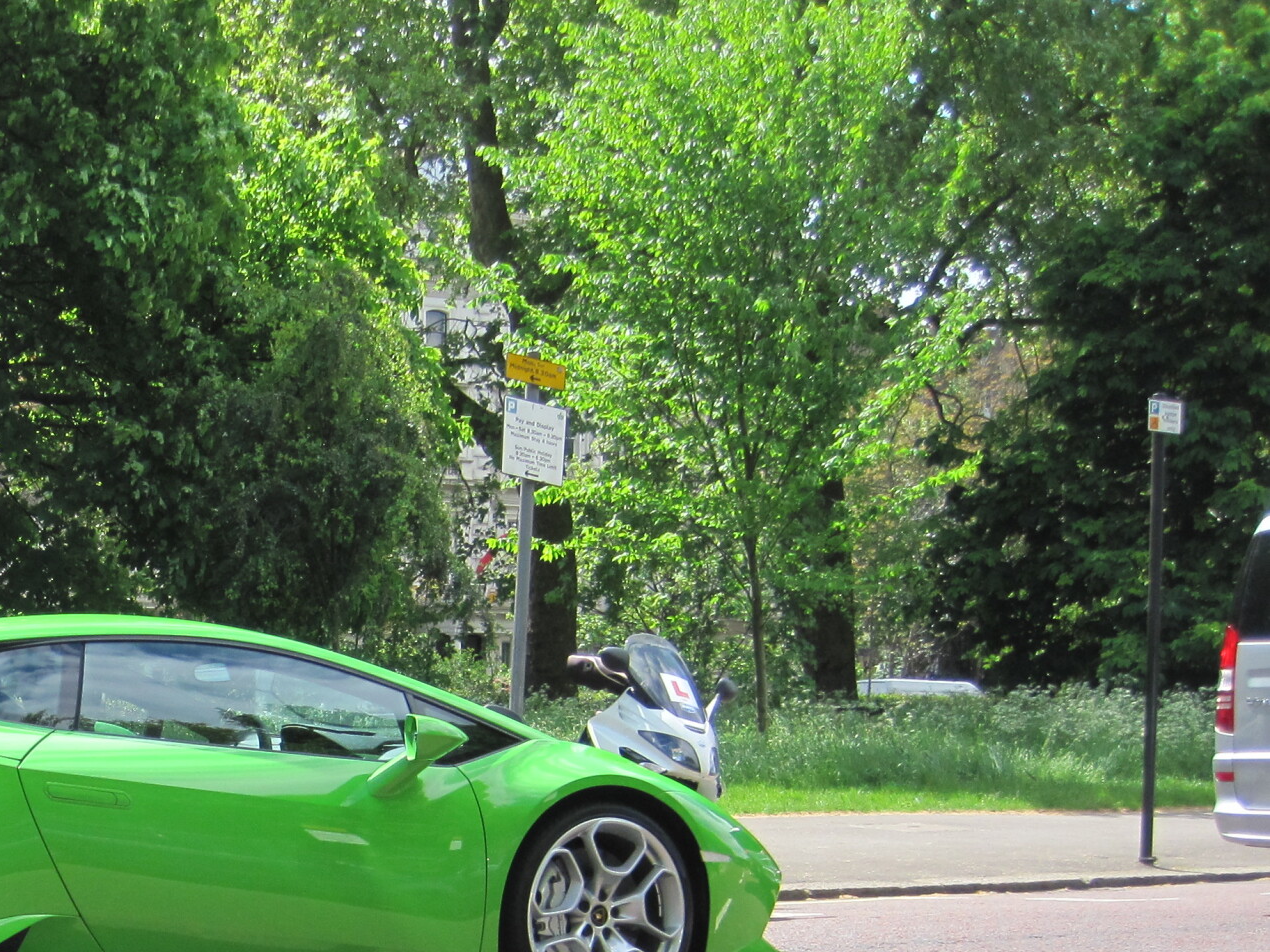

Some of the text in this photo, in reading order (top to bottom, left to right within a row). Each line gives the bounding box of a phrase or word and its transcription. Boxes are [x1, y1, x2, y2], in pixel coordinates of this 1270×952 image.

[508, 400, 515, 412] P
[536, 422, 554, 432] Display
[671, 680, 690, 699] L
